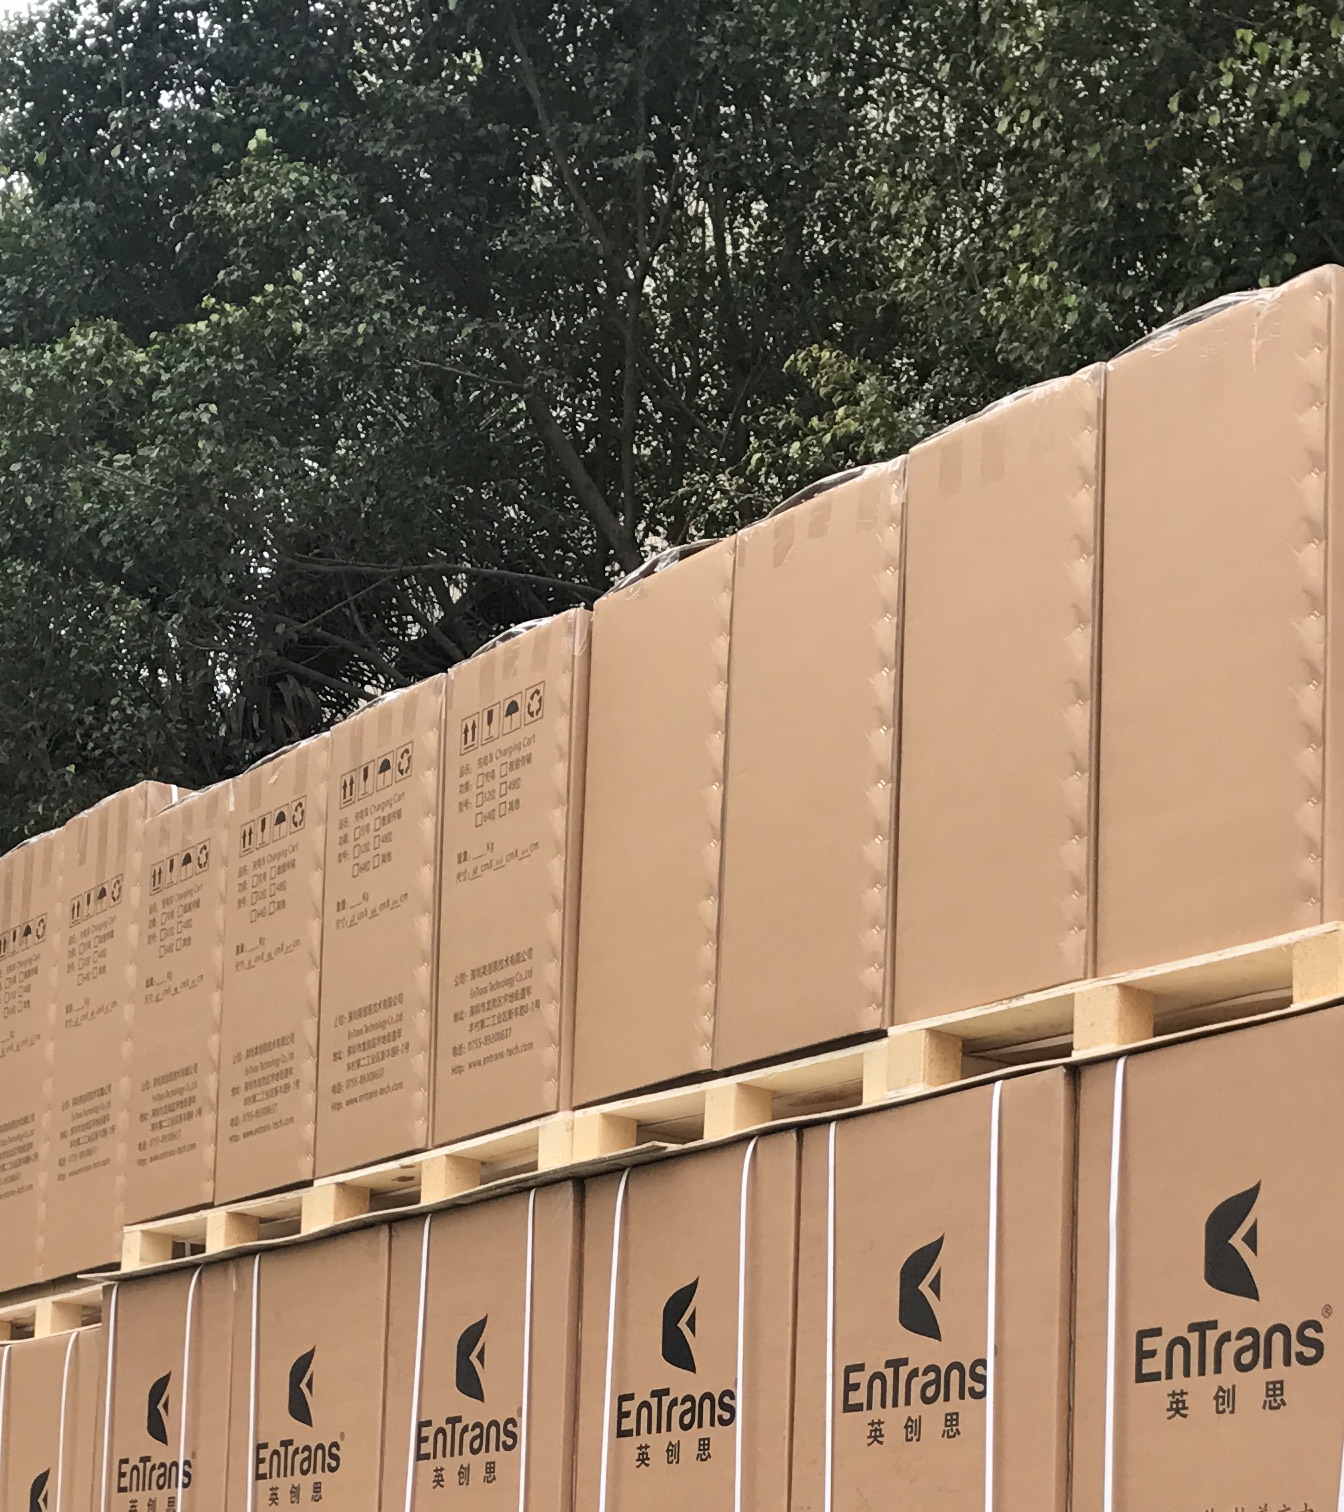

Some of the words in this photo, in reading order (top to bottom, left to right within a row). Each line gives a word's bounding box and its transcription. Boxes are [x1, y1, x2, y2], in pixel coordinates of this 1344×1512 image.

[1134, 1319, 1325, 1384] EnTrans
[842, 1357, 987, 1413] EnTrans
[1166, 1380, 1287, 1420] 英创思
[616, 1388, 736, 1438] EnTrans
[867, 1411, 961, 1446] 英创思
[416, 1415, 518, 1462] EnTrans
[635, 1437, 711, 1468] 英创思
[117, 1456, 192, 1494] EnTrans
[256, 1439, 340, 1481] EnTrans
[432, 1461, 497, 1490] 英创思
[268, 1481, 322, 1506] 英创思
